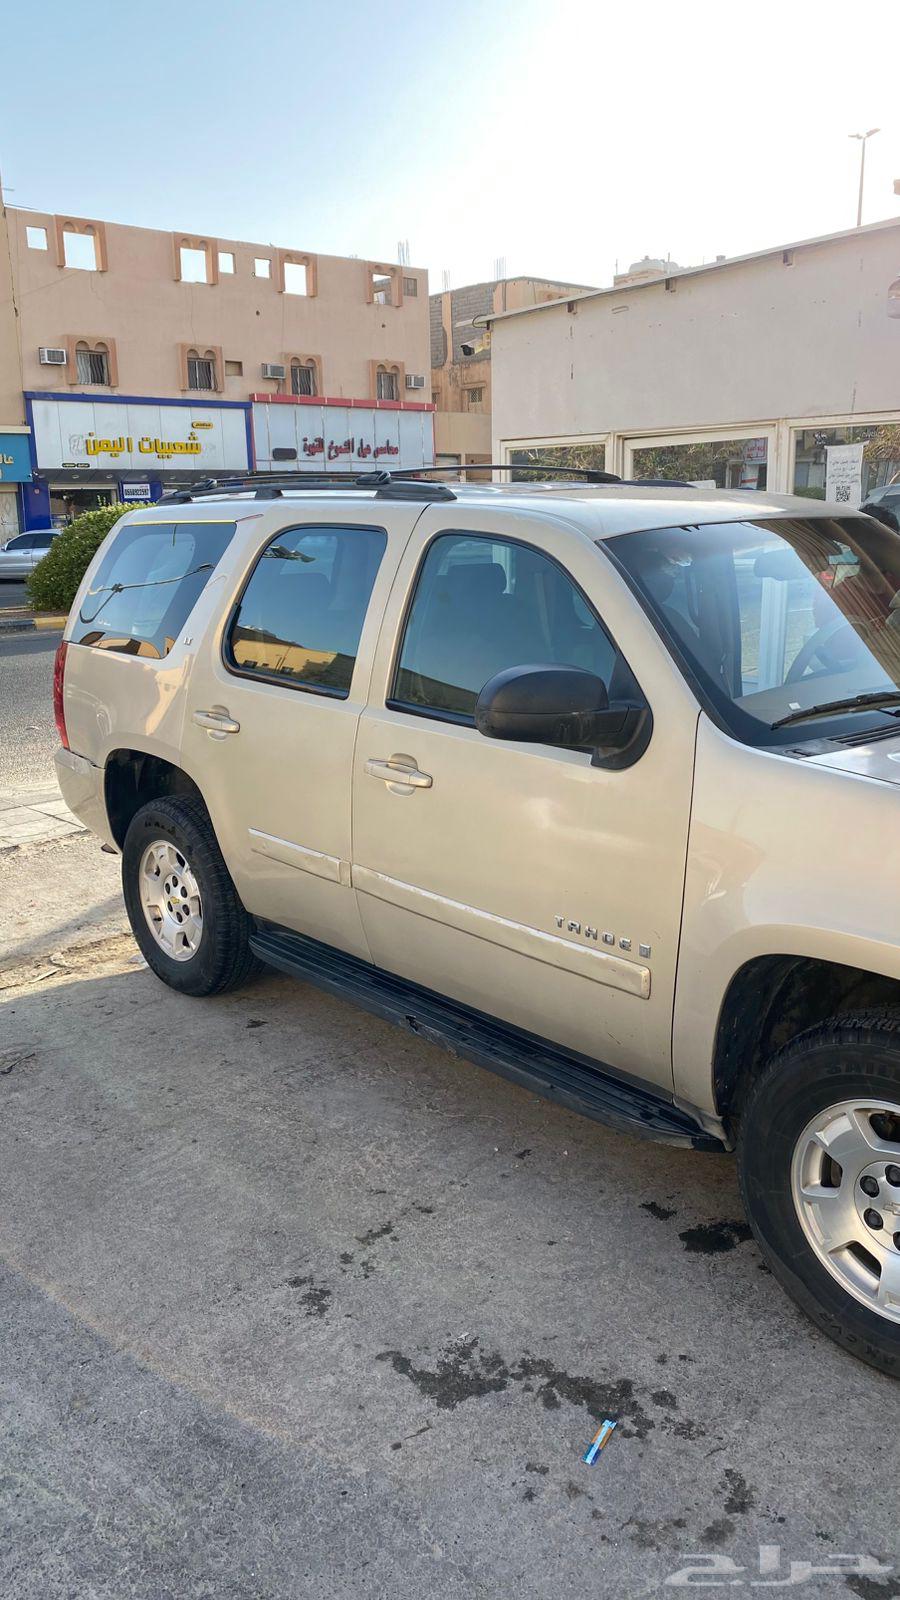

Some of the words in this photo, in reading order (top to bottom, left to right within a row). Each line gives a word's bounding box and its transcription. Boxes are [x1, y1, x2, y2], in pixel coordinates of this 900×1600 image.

[85, 432, 133, 458] اليمن
[138, 432, 202, 459] شعبيات
[554, 914, 632, 952] TAHOE
